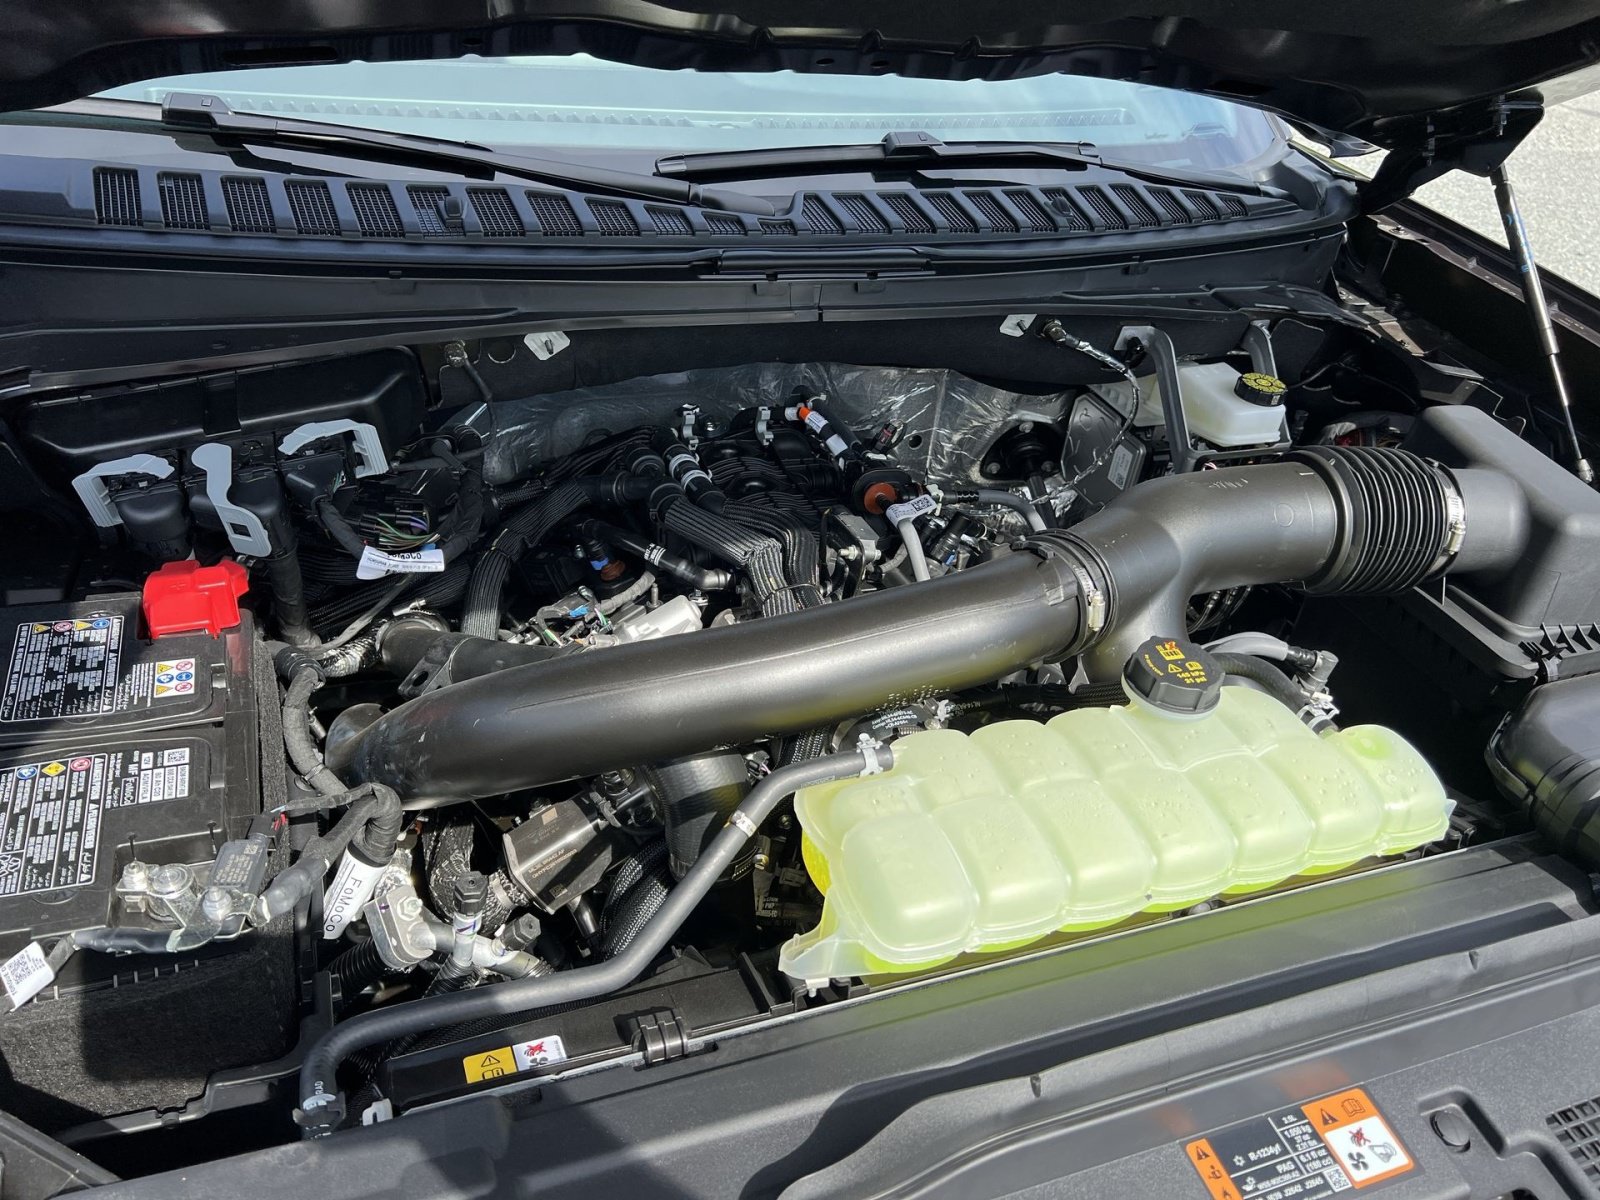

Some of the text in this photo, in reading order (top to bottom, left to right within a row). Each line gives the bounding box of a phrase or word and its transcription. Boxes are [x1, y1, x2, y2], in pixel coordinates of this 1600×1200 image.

[127, 763, 138, 775] MF
[123, 778, 135, 804] FoMoCo
[325, 876, 361, 933] FoMoCo
[315, 1080, 324, 1095] RAD
[1301, 1124, 1313, 1134] kg
[1247, 1143, 1282, 1162] R-1234yf
[1299, 1153, 1311, 1163] 6.1
[1275, 1161, 1295, 1174] PAG
[1305, 1156, 1334, 1173] (180 cc)
